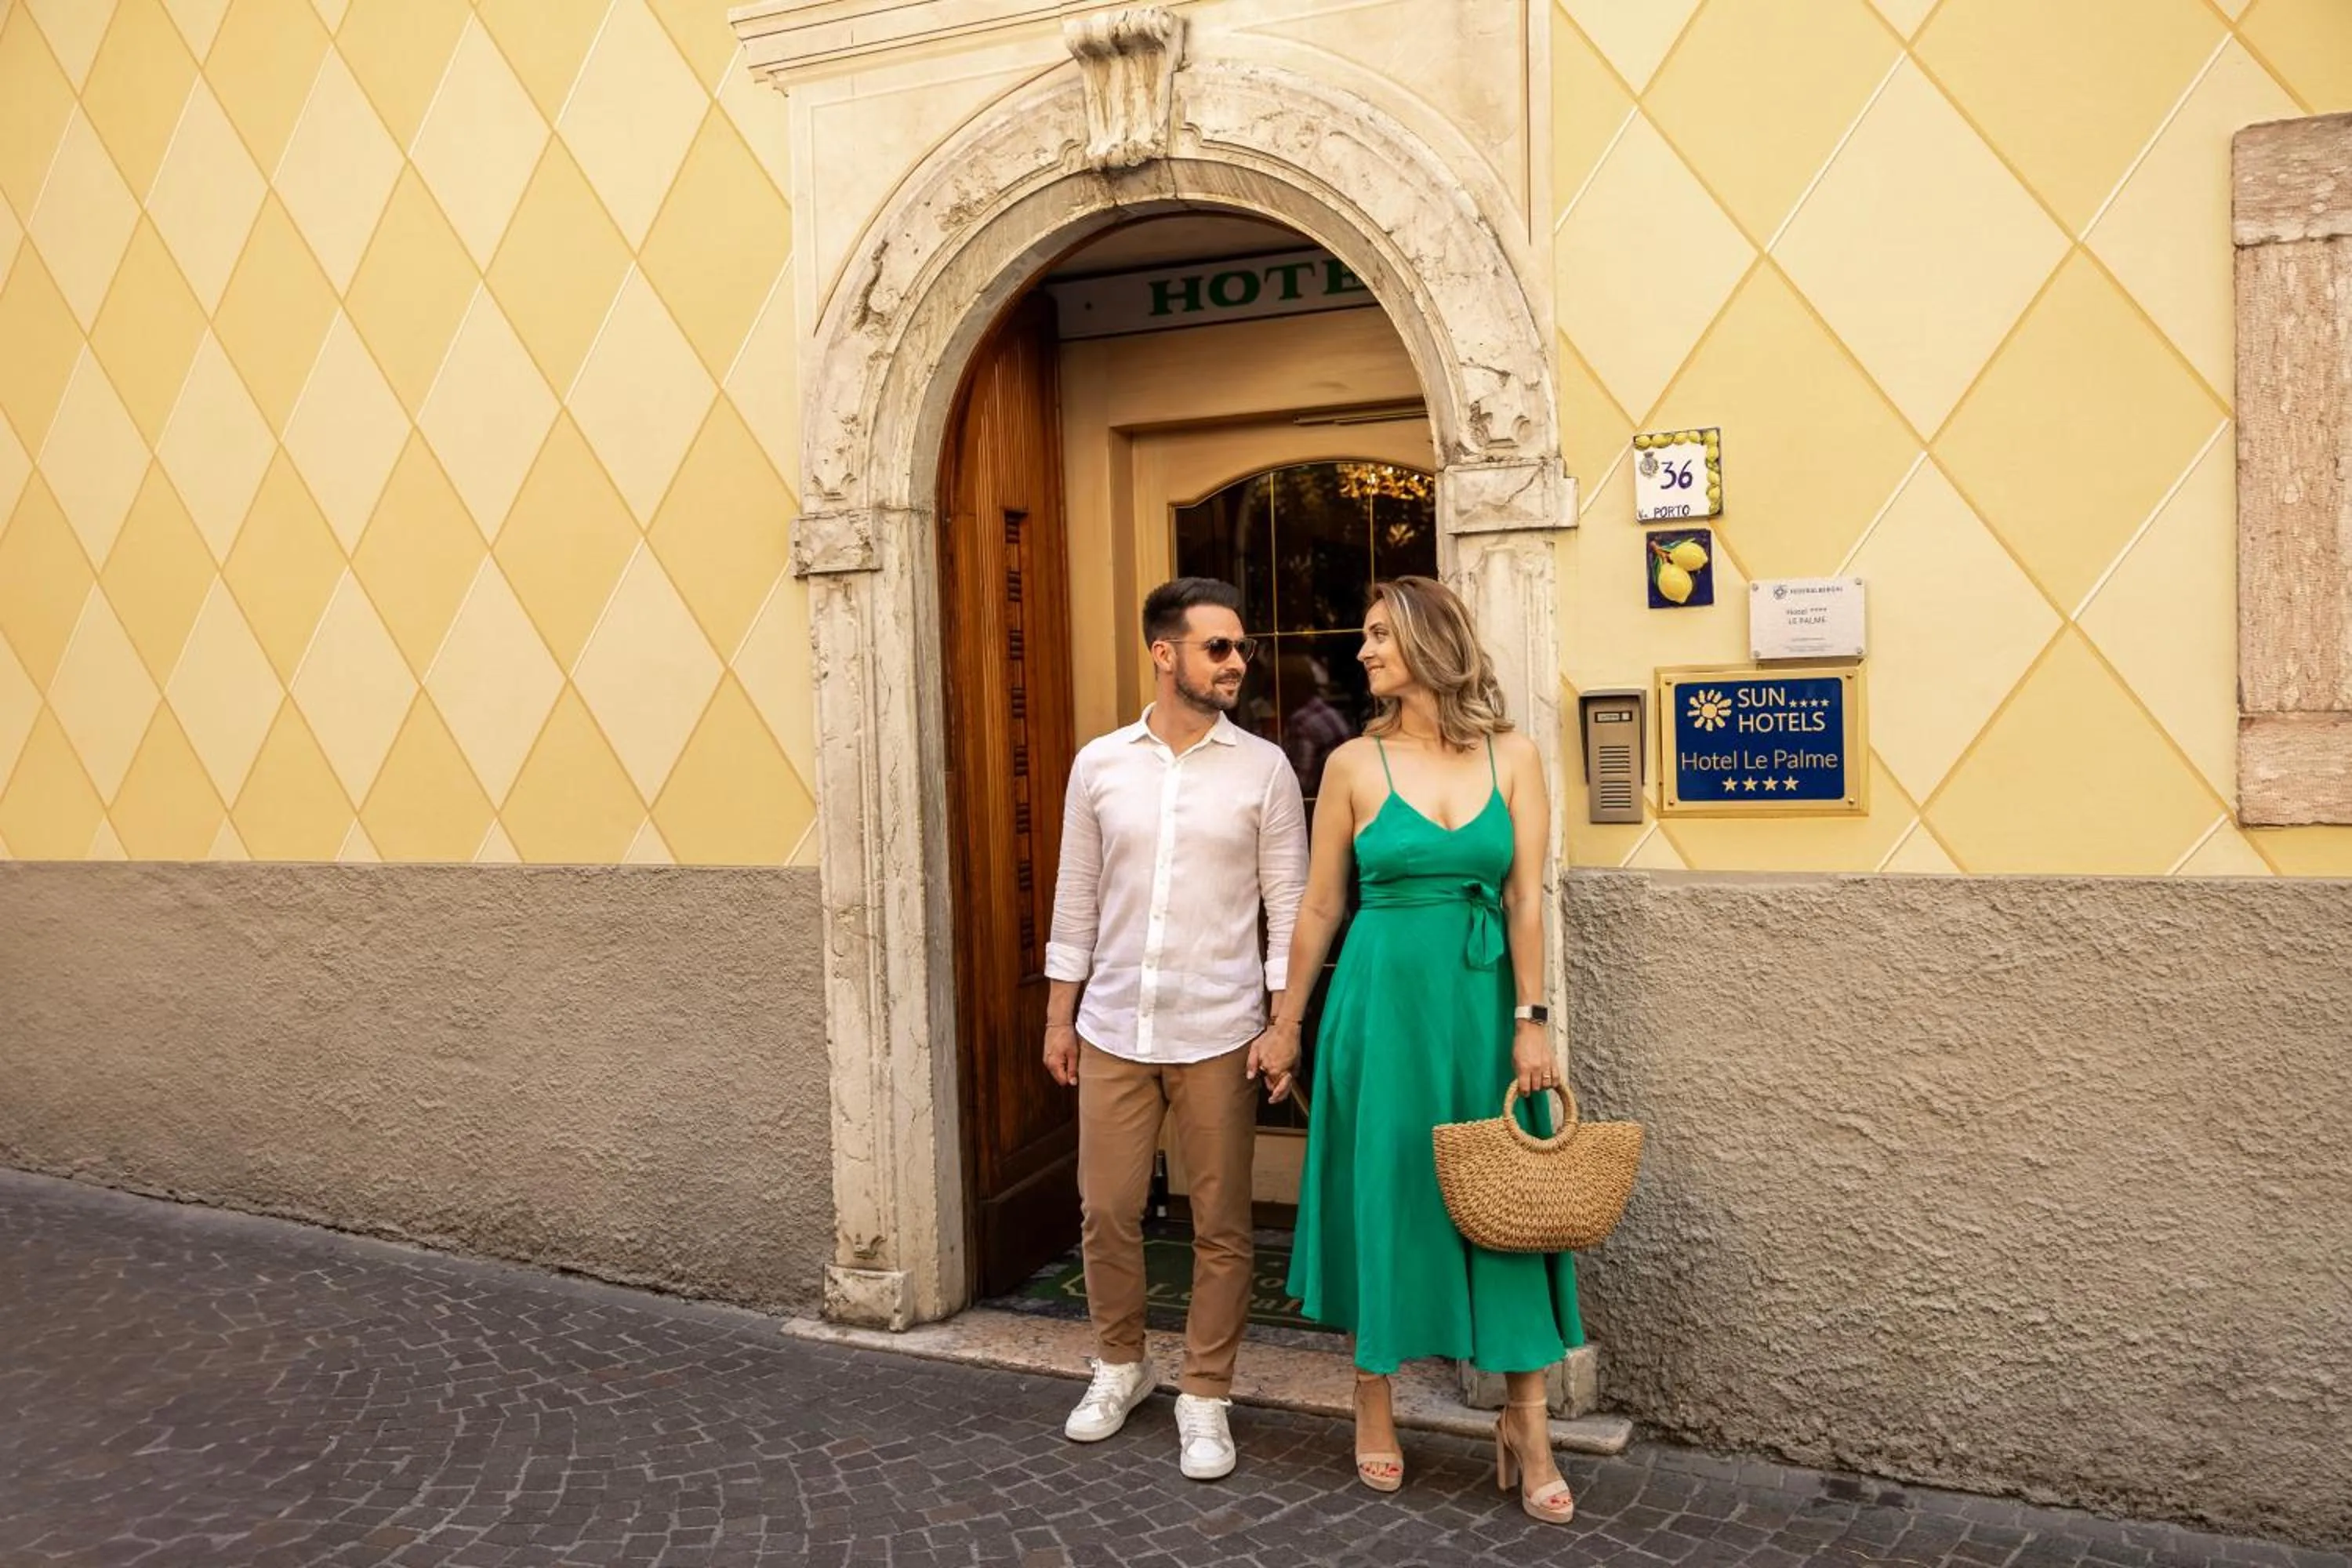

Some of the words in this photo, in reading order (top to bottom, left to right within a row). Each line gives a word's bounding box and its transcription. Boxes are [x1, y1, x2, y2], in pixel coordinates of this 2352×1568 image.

[1661, 459, 1693, 489] 36
[1653, 504, 1691, 518] PORTO
[1737, 687, 1786, 708] SUN
[1737, 711, 1826, 733] HOTELS
[1681, 750, 1737, 771] Hotel
[1744, 750, 1769, 770] Le
[1773, 748, 1838, 770] Palme
